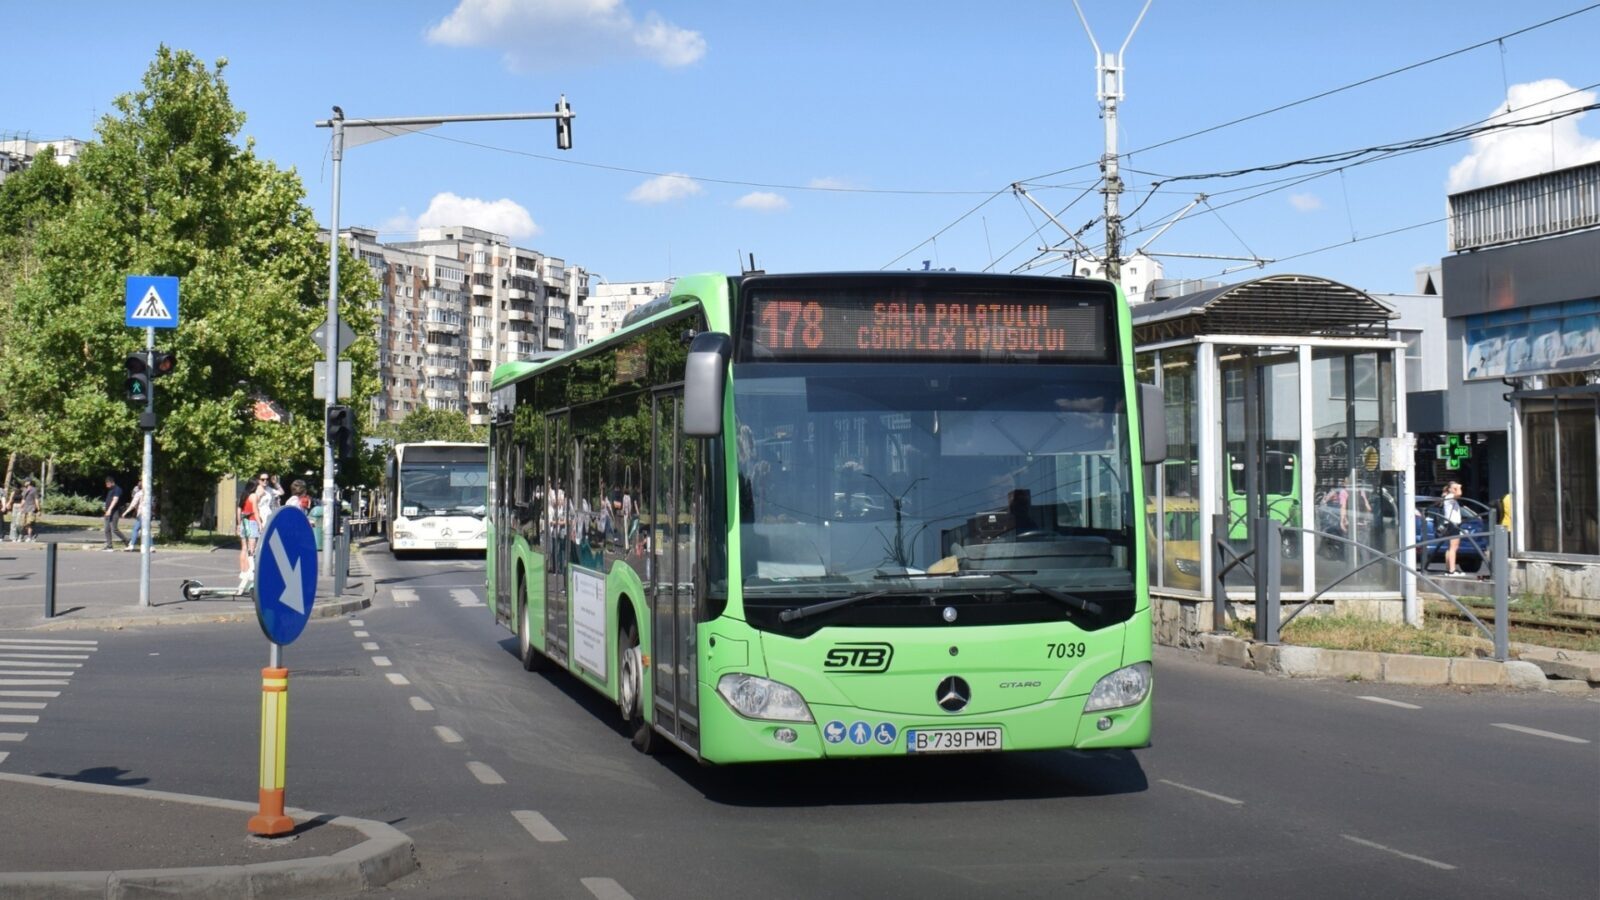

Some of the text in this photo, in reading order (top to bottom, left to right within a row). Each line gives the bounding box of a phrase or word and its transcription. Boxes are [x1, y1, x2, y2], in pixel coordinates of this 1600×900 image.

[762, 301, 824, 348] 178
[874, 303, 1048, 327] SALA PALATULUI
[857, 327, 1065, 351] COMPLEX APUSULUI
[823, 647, 888, 668] STB
[1047, 642, 1086, 659] 7039
[999, 681, 1042, 689] CITARO
[917, 733, 928, 749] B
